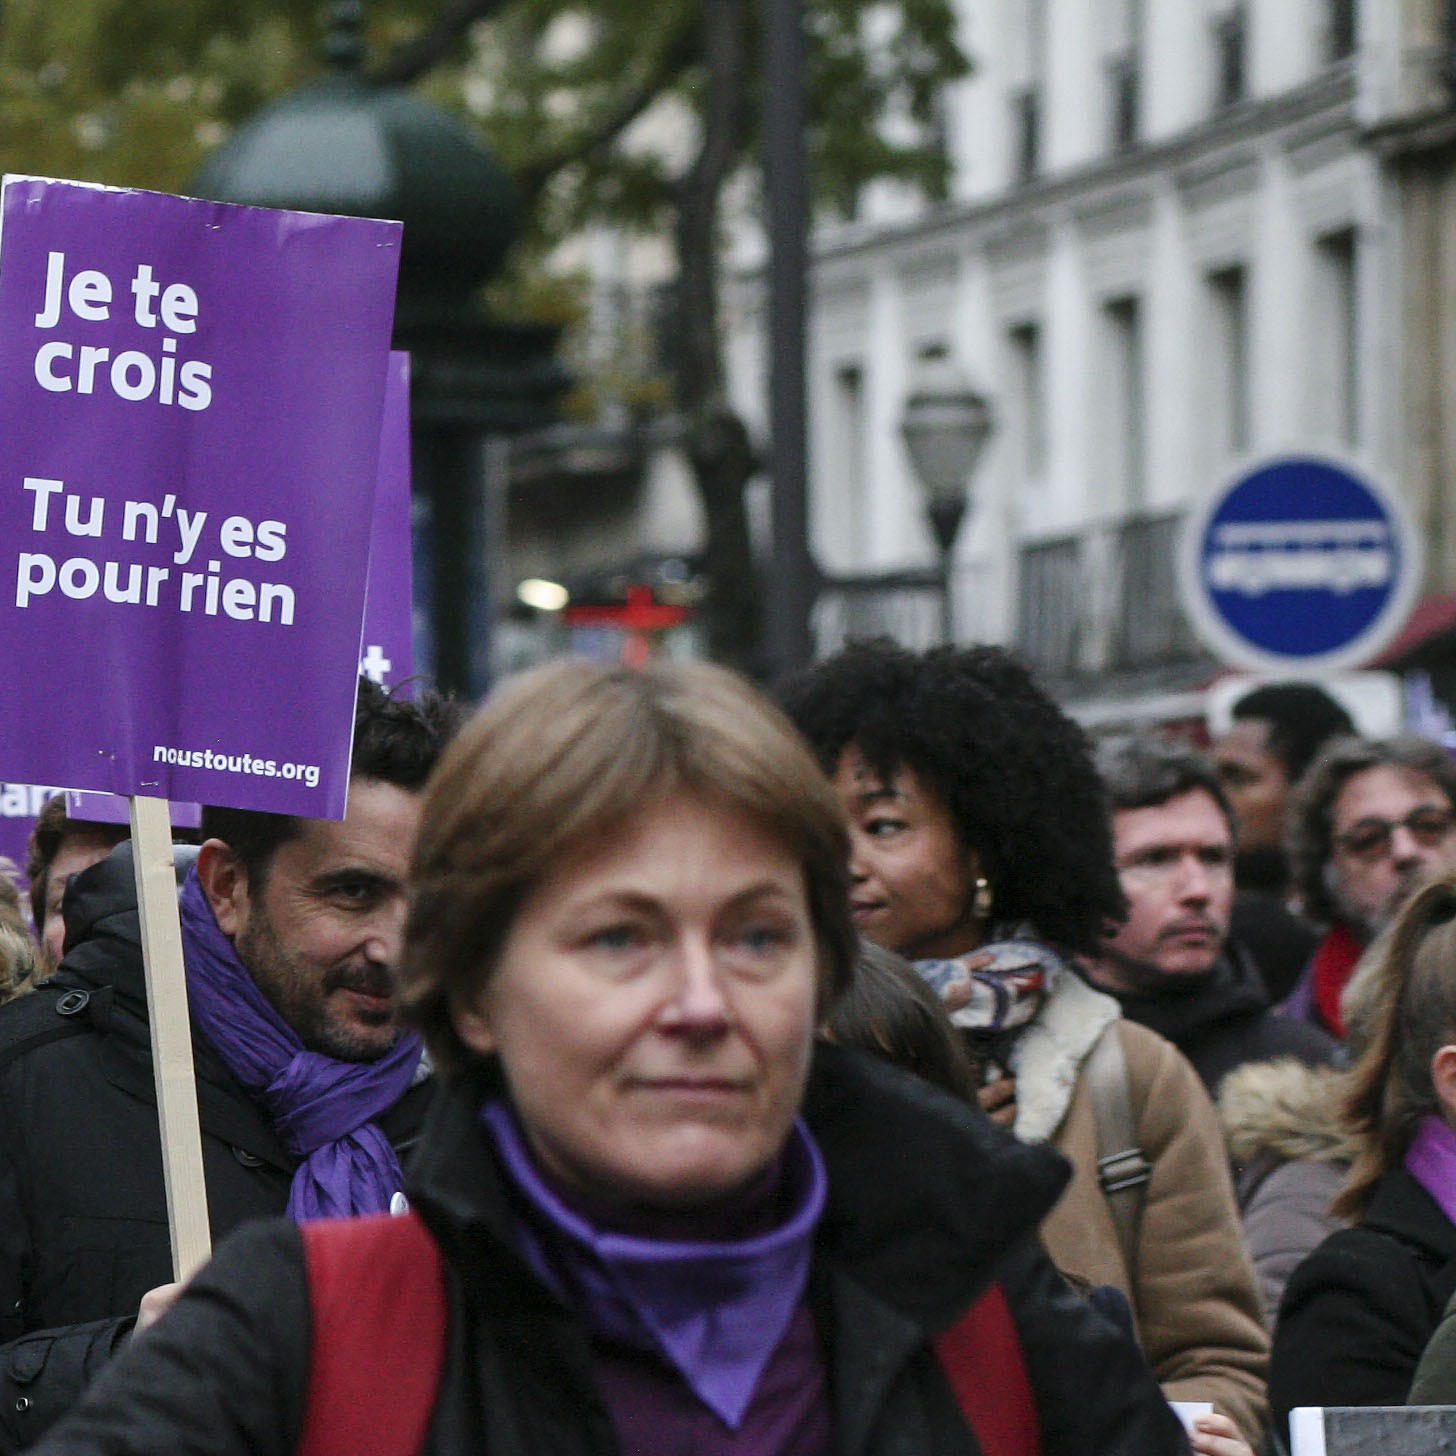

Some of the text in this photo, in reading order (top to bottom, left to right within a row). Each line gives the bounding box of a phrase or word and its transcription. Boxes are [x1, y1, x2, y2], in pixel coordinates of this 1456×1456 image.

[34, 251, 199, 334] Je te
[34, 337, 213, 411] crois
[23, 477, 287, 566] Tu n'y es
[15, 552, 171, 609] pour
[180, 568, 296, 626] rien
[153, 745, 320, 787] noustoutes.org
